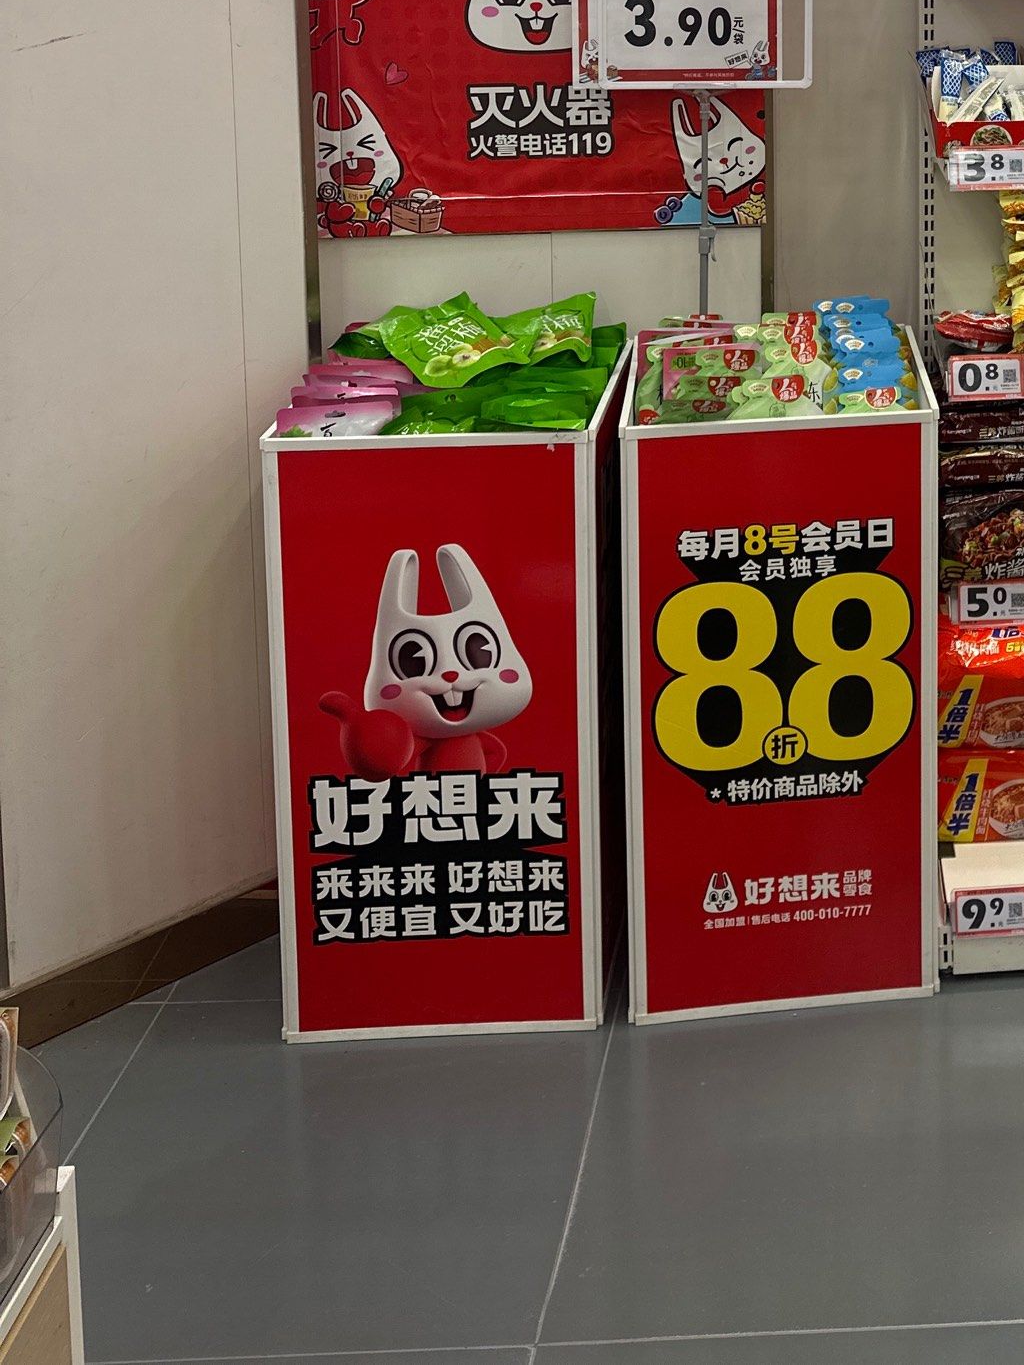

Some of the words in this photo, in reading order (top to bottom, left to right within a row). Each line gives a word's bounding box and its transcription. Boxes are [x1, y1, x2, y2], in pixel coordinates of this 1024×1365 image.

[467, 85, 613, 129] 灭火器
[469, 132, 613, 158] 火警电话119
[964, 154, 1005, 182] 3.8
[958, 363, 999, 392] 0.8
[678, 518, 894, 560] 每月8号会员日
[738, 555, 837, 581] 会员独享
[967, 587, 1007, 617] 5.0
[655, 572, 914, 772] 88
[771, 732, 799, 760] 折
[313, 773, 565, 846] 好想来
[946, 772, 979, 836] 1倍半
[316, 862, 436, 899] 来来来
[447, 859, 565, 894] 好想来
[744, 872, 841, 906] 好想来
[843, 869, 872, 883] 品牌
[843, 883, 873, 897] 零食
[318, 906, 437, 941] 又便宜
[449, 901, 566, 934] 又好吃
[703, 916, 746, 930] 全国加盟
[751, 912, 791, 926] 售后电话
[793, 904, 872, 922] 400-010-7777
[962, 897, 1004, 929] 9.9
